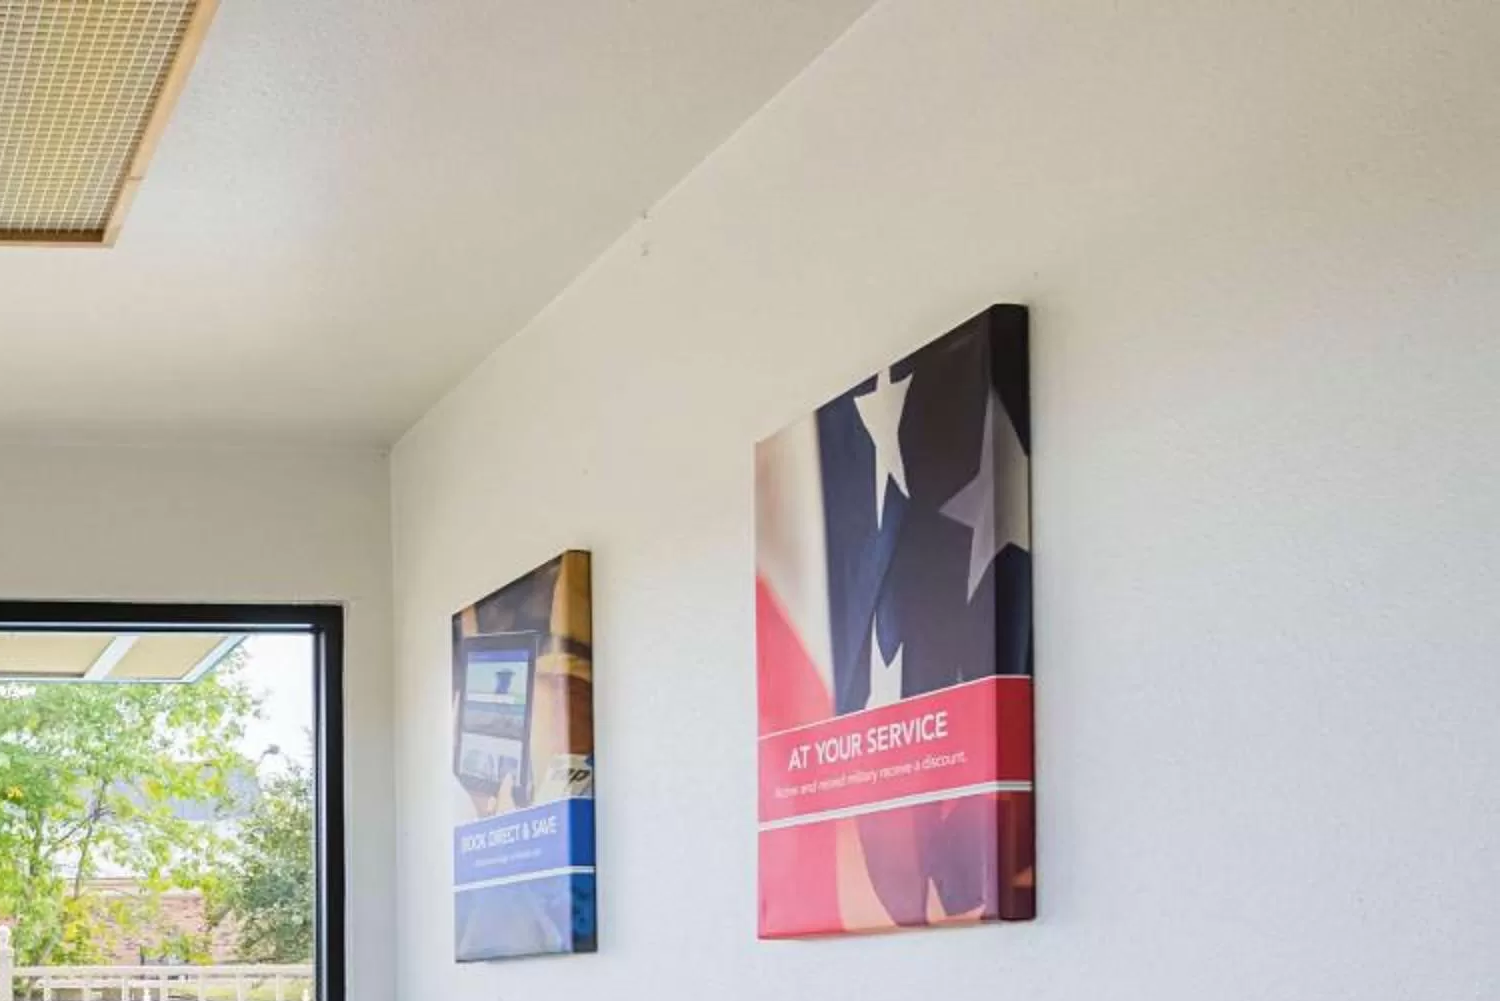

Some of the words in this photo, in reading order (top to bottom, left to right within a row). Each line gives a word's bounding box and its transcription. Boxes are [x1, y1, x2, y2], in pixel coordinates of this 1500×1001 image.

[787, 746, 811, 772] AT
[815, 732, 863, 765] YOUR
[867, 711, 949, 753] SERVICE
[532, 815, 558, 838] SAVE
